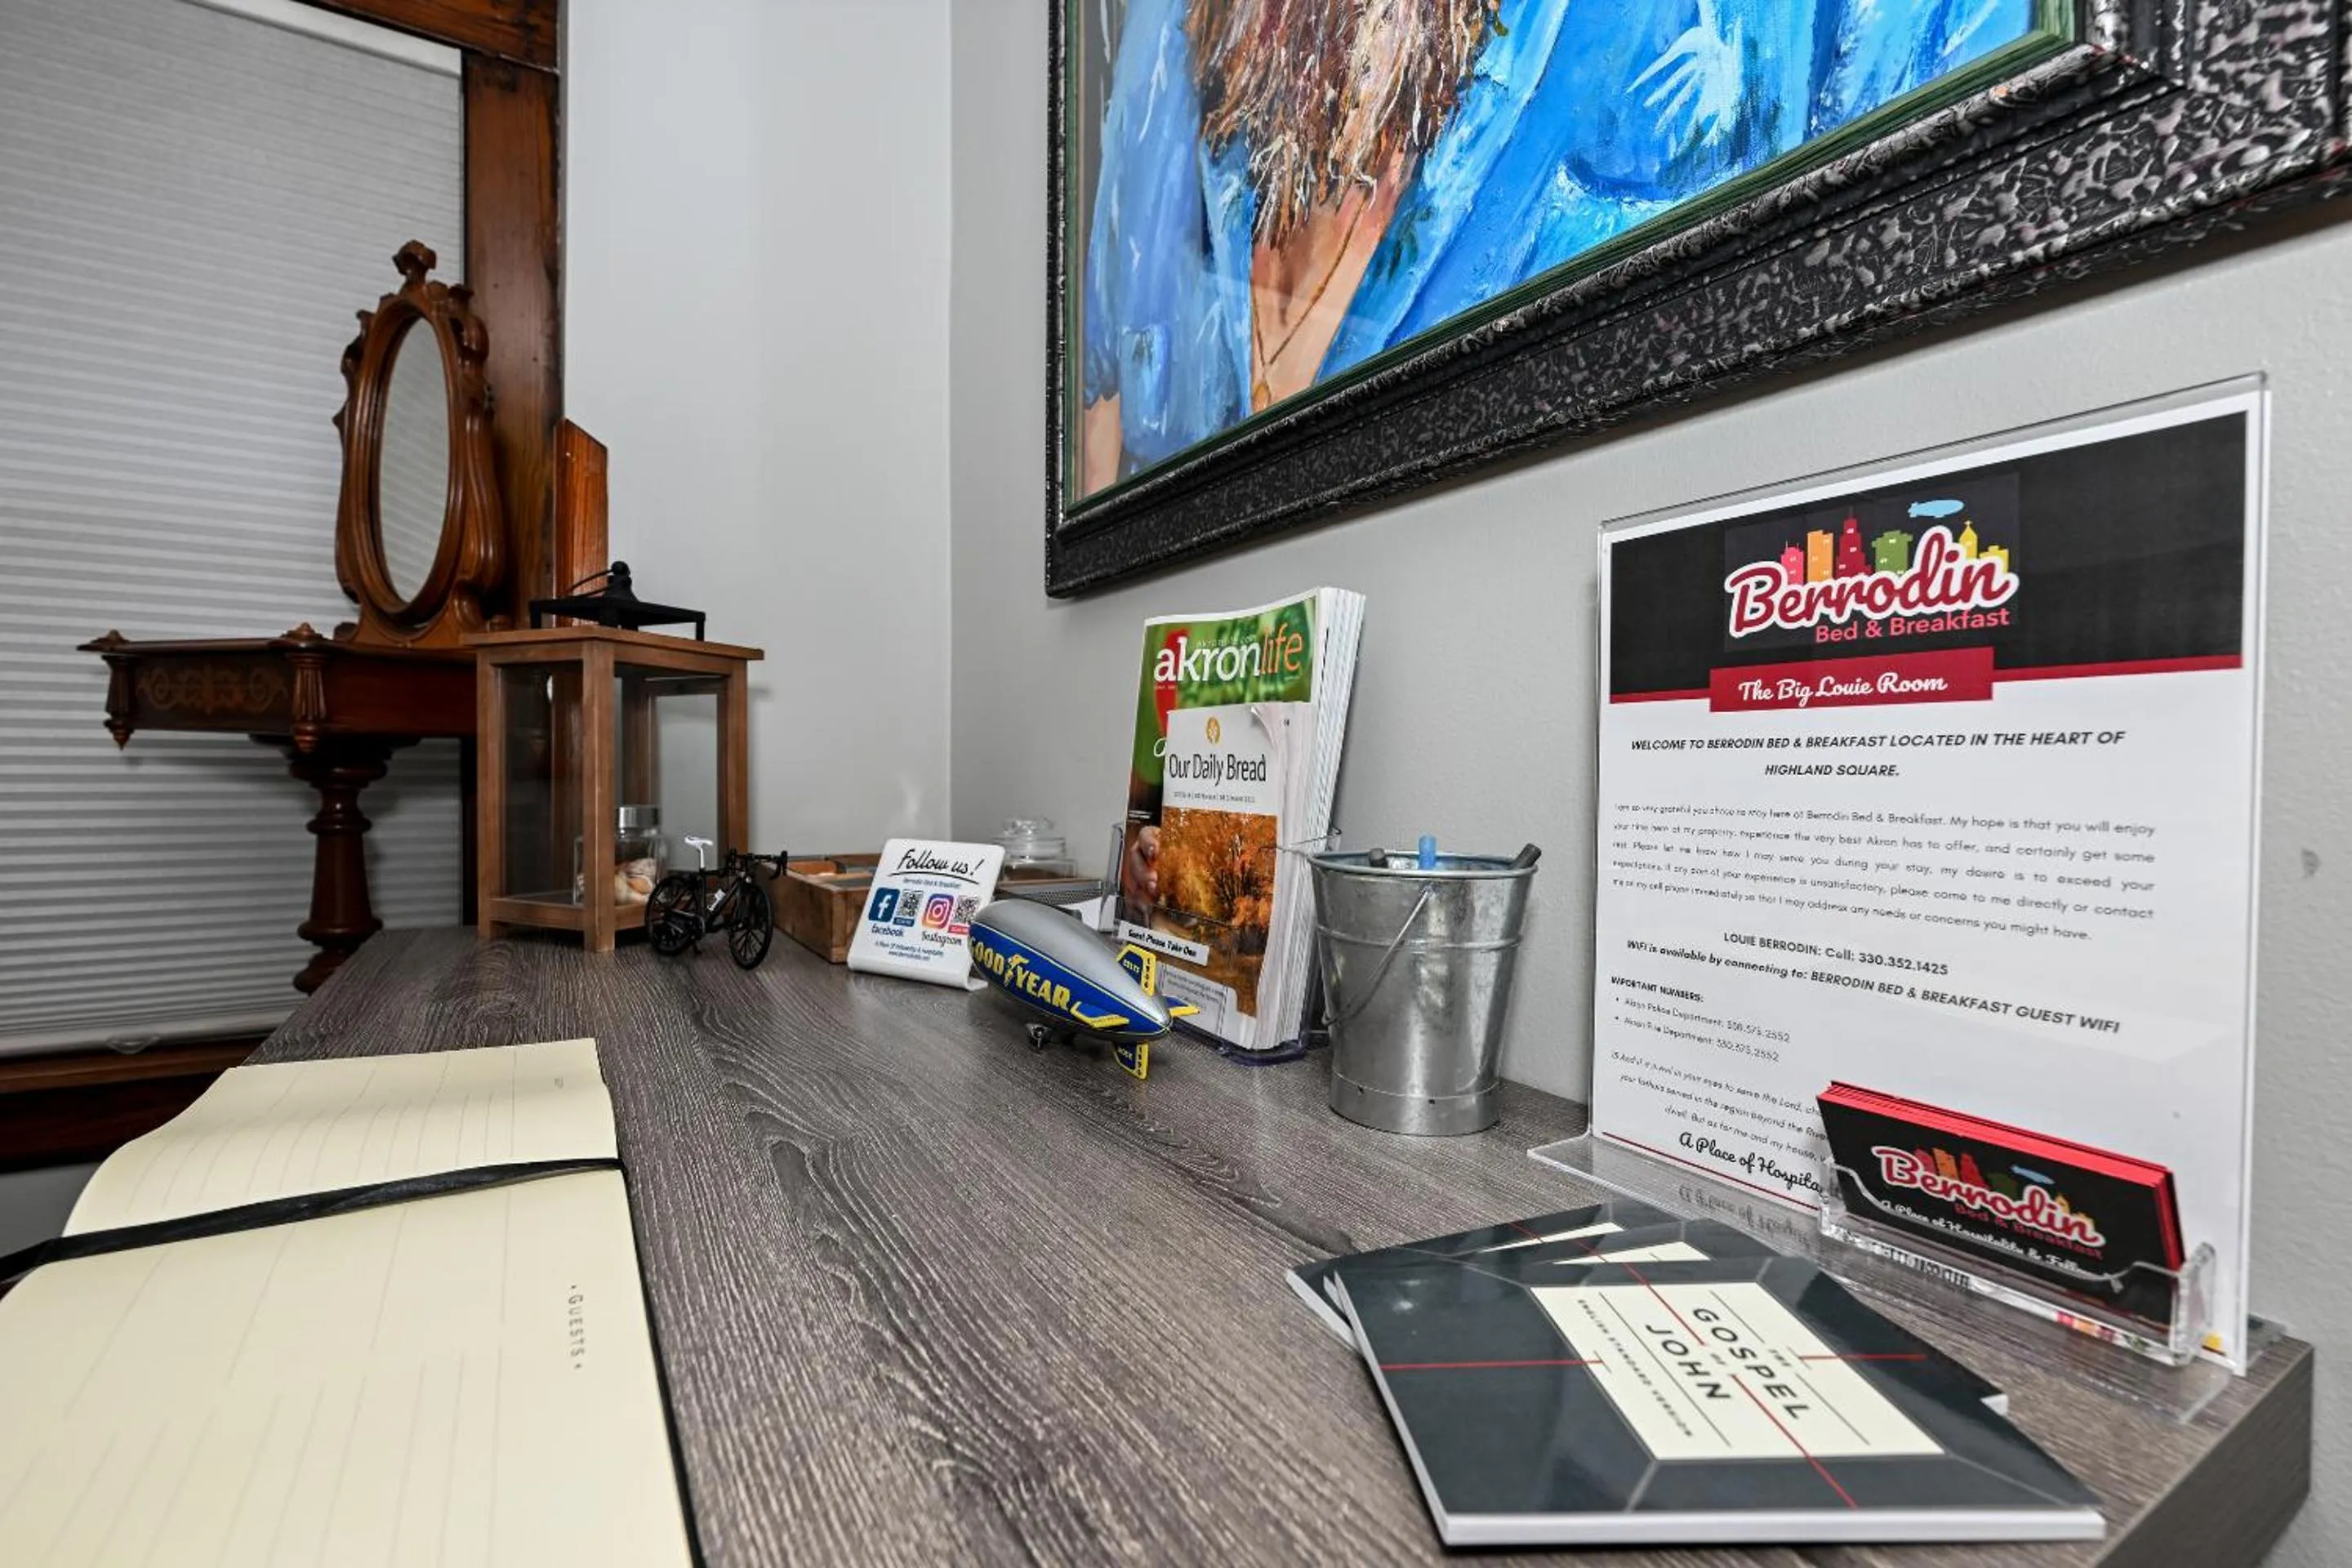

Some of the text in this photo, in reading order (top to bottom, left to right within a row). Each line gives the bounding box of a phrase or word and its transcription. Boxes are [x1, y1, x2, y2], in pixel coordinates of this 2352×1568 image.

[1725, 525, 2019, 638] Berrodin
[1815, 608, 2010, 643] Bed & Breakfast
[1738, 672, 1947, 706] The Big Louie Room
[1632, 732, 2125, 750] WELCOME TO BERRODIN BED & BREAKFAST LOCATED IN THE HEART OF
[1169, 754, 1266, 786] Our Daily Bread
[1766, 765, 1899, 776] HIGHLAND SQUARE.
[1852, 812, 1873, 822] Bed
[1888, 813, 1944, 825] Breakfast.
[1950, 817, 1967, 828] My
[1972, 816, 2004, 829] hope
[2024, 820, 2051, 830] that
[2056, 823, 2081, 833] you
[2086, 822, 2109, 831] will
[2114, 826, 2154, 837] enjoy
[898, 849, 949, 871] Follow
[1740, 831, 1789, 840] experience
[1794, 832, 1810, 840] the
[1814, 835, 1834, 844] very
[1839, 835, 1861, 844] best
[1903, 838, 1922, 849] has
[1945, 840, 1979, 853] offer,
[1985, 844, 2010, 853] and
[2016, 847, 2076, 861] certainly
[2082, 851, 2107, 861] get
[2114, 853, 2155, 862] some
[1754, 853, 1774, 862] may
[1811, 858, 1829, 866] you
[1835, 858, 1868, 871] during
[1875, 862, 1899, 871] your
[1906, 865, 1932, 875] stay,
[1940, 868, 1958, 878] my
[1966, 867, 2005, 879] desire
[2034, 874, 2047, 882] to
[2057, 876, 2111, 887] exceed
[2122, 882, 2154, 891] your
[1744, 873, 1796, 884] experience
[1811, 880, 1886, 895] unsatisfactory,
[1891, 884, 1928, 898] please
[1934, 892, 1967, 900] come
[1973, 893, 1985, 902] to
[1991, 897, 2011, 905] me
[2016, 896, 2068, 913] directly
[2094, 906, 2154, 918] contact
[871, 924, 904, 938] facebook
[1759, 894, 1775, 903] that
[1785, 899, 1805, 909] may
[1807, 900, 1847, 911] address
[1851, 906, 1869, 915] any
[1873, 909, 1906, 919] needs
[1925, 915, 1980, 927] concerns
[1984, 921, 2006, 930] you
[2011, 924, 2048, 937] might
[2053, 926, 2091, 939] have.
[922, 931, 963, 947] Instagram
[1146, 934, 1165, 947] Please
[1168, 941, 1183, 951] Take
[1183, 947, 1196, 957] One
[1725, 933, 1755, 946] LOUIE
[1759, 938, 1821, 956] BERRODIN:
[1860, 953, 1948, 975] 330.352.1425
[1660, 948, 1706, 961] available
[1709, 953, 1722, 966] by
[1725, 960, 1788, 978] connecting
[1792, 969, 1807, 978] to:
[1811, 971, 1874, 991] BERRODIN
[1878, 982, 1904, 995] BED
[1907, 987, 1916, 998] &
[1921, 991, 2012, 1013] BREAKFAST
[2016, 1006, 2075, 1025] GUEST
[2080, 1016, 2120, 1033] WIFI
[1762, 1093, 1777, 1103] the
[1806, 1126, 1828, 1141] Rive
[1679, 1132, 1823, 1196] A Place of Hospita
[1872, 1145, 2105, 1247] Berrodin
[568, 1294, 586, 1358] GUESTS
[1645, 1324, 1731, 1400] JOHN
[1693, 1307, 1811, 1419] GOSPEL
